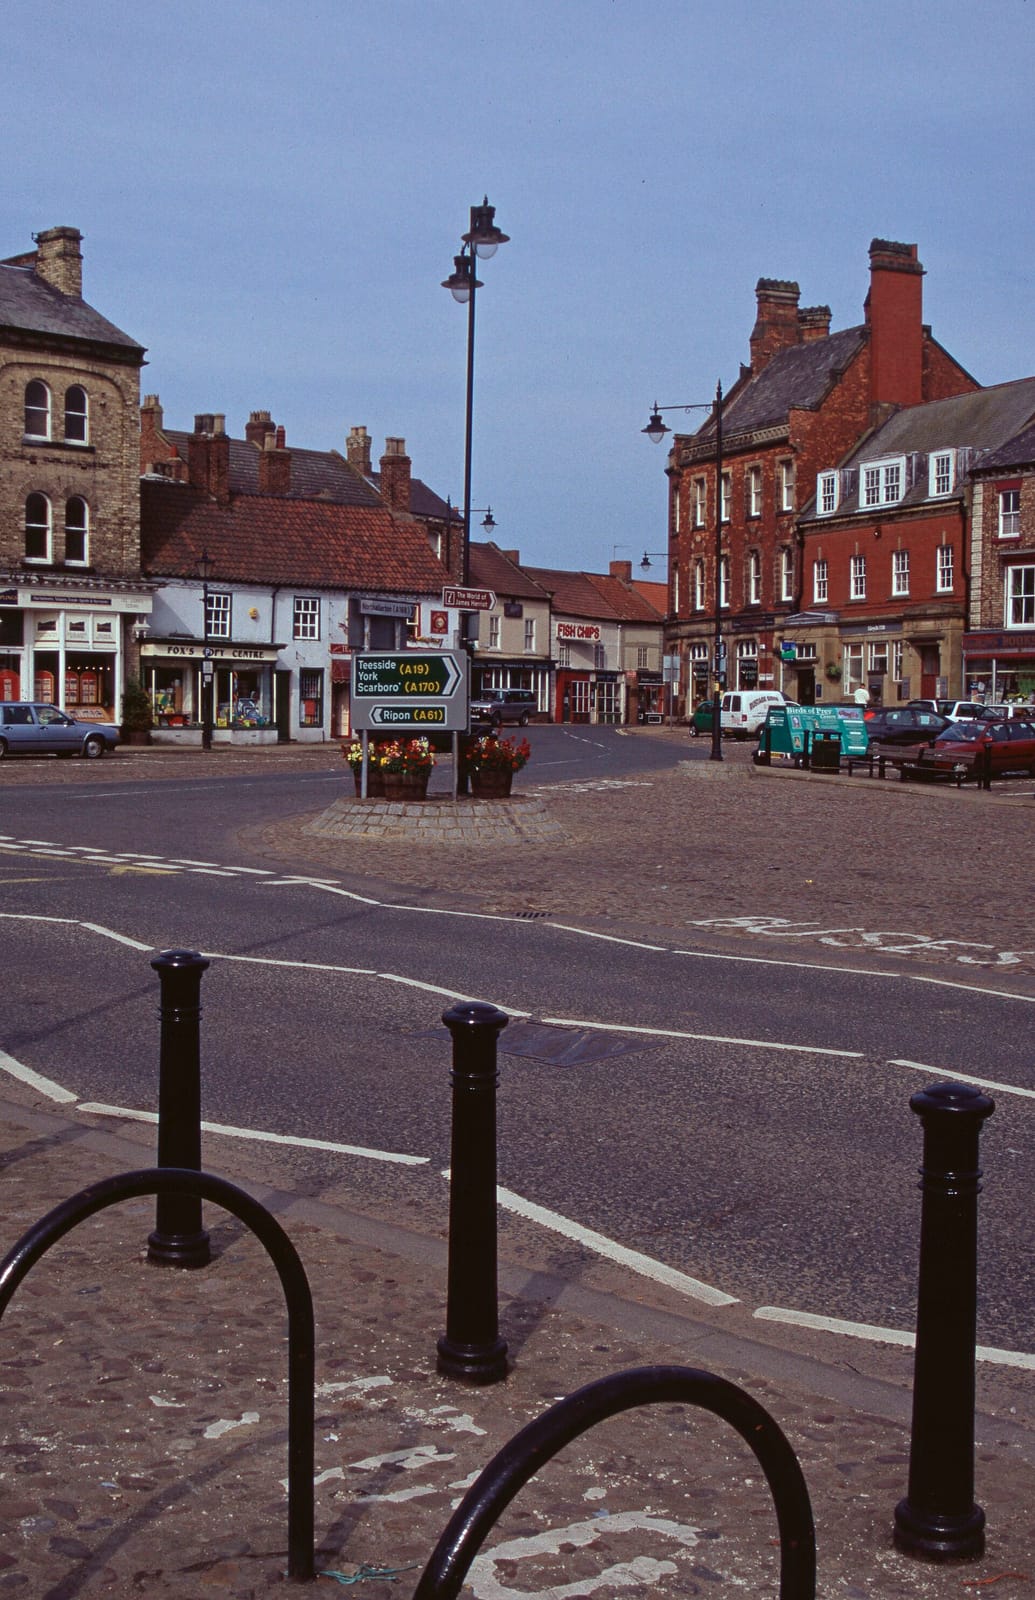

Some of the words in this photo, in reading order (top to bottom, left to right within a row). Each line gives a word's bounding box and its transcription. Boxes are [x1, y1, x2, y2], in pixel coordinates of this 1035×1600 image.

[557, 623, 576, 637] FISH
[577, 625, 600, 639] CHIPS
[167, 646, 194, 655] FOX'S
[232, 649, 265, 659] CENTRE
[358, 660, 396, 670] Teesside
[399, 664, 430, 675] (A19)
[358, 671, 378, 681] York
[357, 682, 401, 692] Scarboro'
[404, 681, 440, 693] (A170)
[383, 710, 410, 721] Ripon
[414, 709, 443, 720] (A61)
[816, 707, 832, 716] Prey
